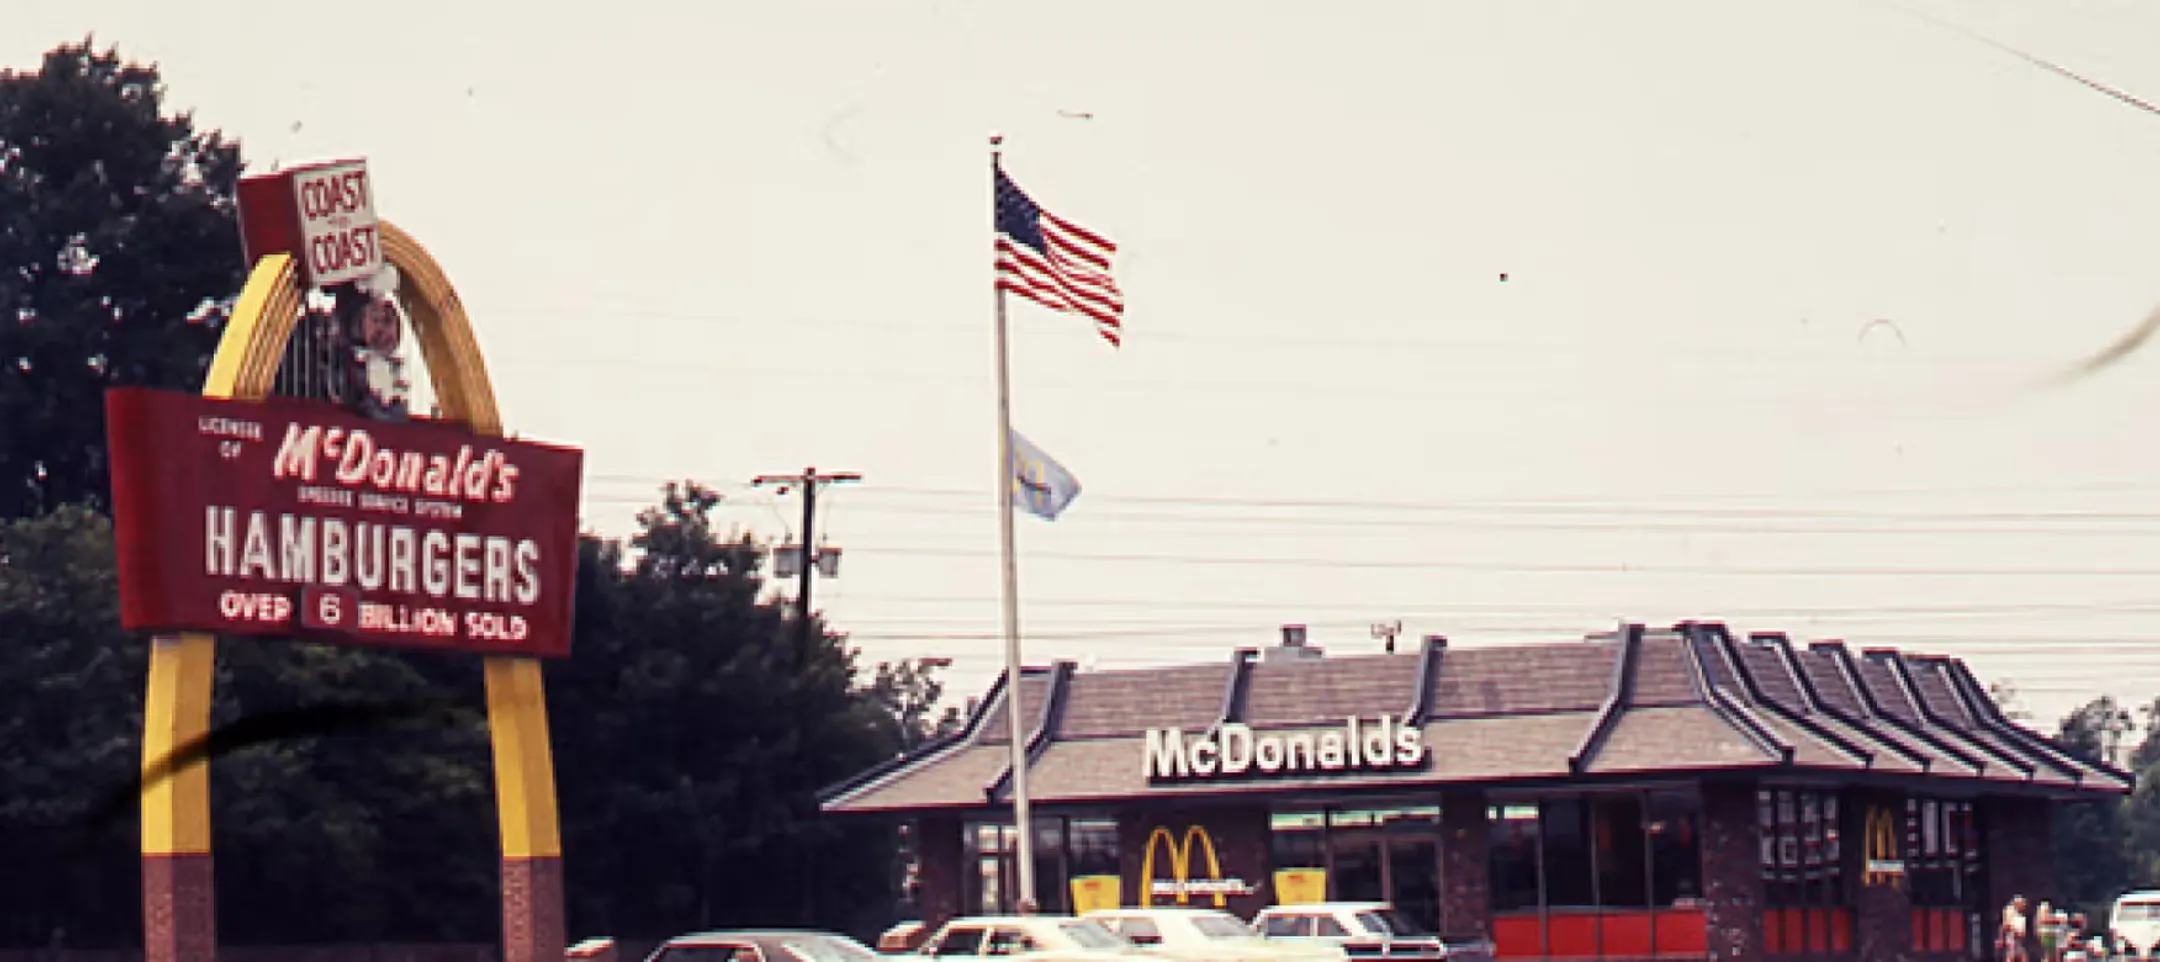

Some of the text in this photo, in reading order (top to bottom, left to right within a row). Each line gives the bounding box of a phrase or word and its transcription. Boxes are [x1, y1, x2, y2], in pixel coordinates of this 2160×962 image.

[302, 170, 367, 219] COAST
[313, 225, 376, 273] COAST
[274, 421, 520, 501] McDonald's
[205, 505, 541, 606] HAMBURGERS
[219, 590, 529, 641] OVER 6 BILLION SOLD
[1145, 713, 1424, 779] McDonalds
